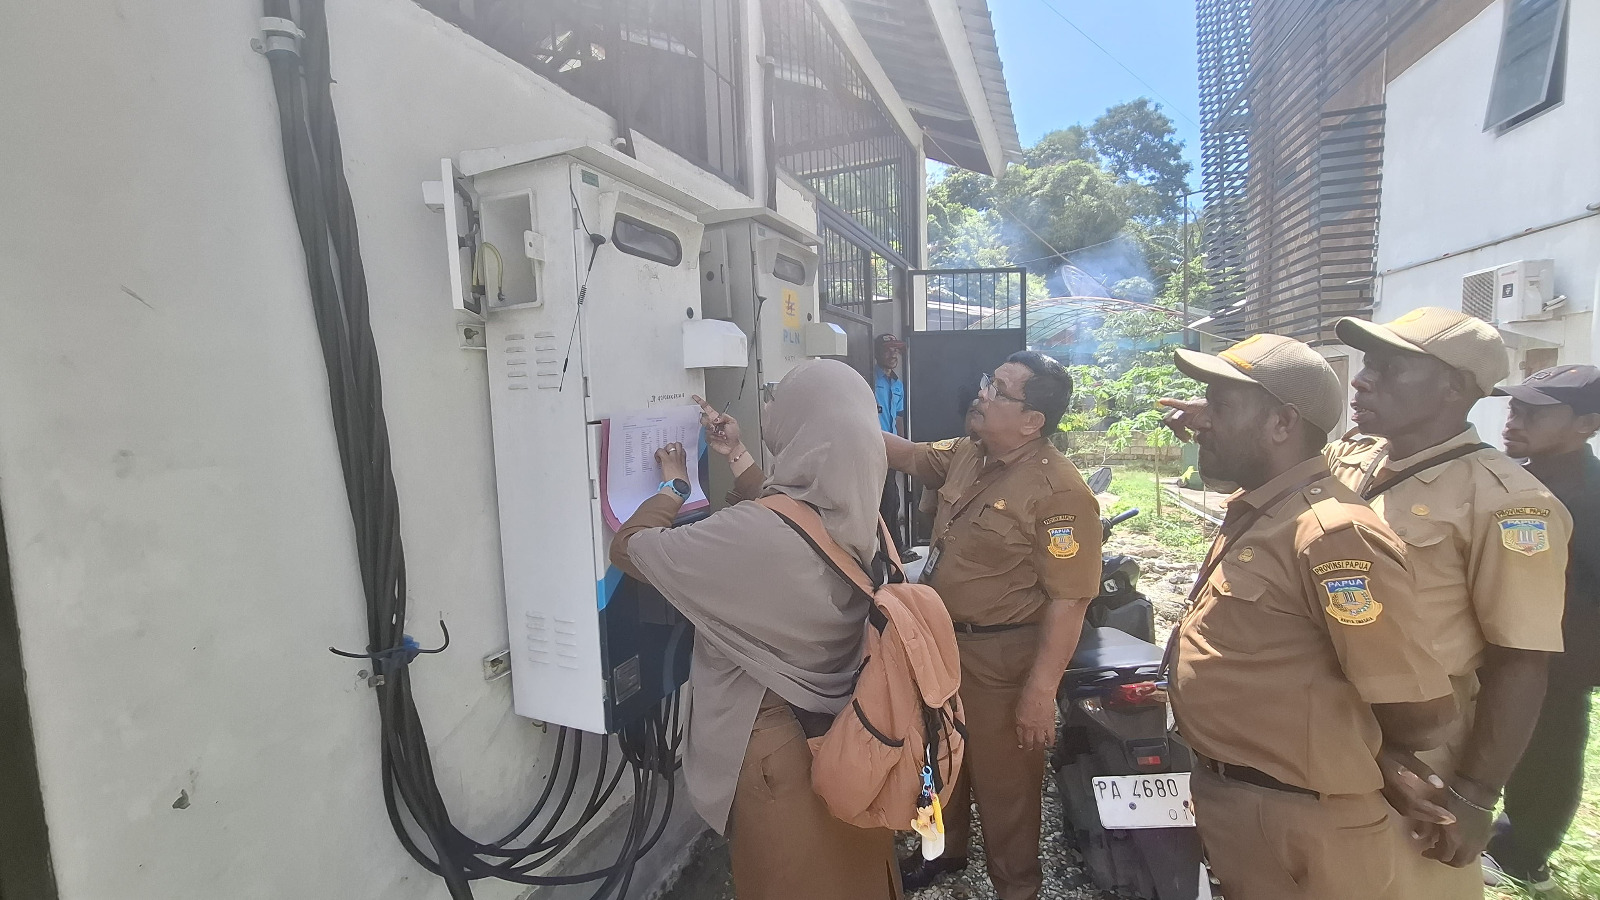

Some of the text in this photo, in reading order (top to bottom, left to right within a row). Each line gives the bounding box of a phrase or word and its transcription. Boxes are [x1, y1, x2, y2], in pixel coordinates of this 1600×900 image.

[783, 328, 800, 345] PLN
[1314, 561, 1368, 575] PROVINSI PAPUA
[1327, 579, 1364, 588] PAPUA
[1095, 778, 1179, 799] PA 4680
